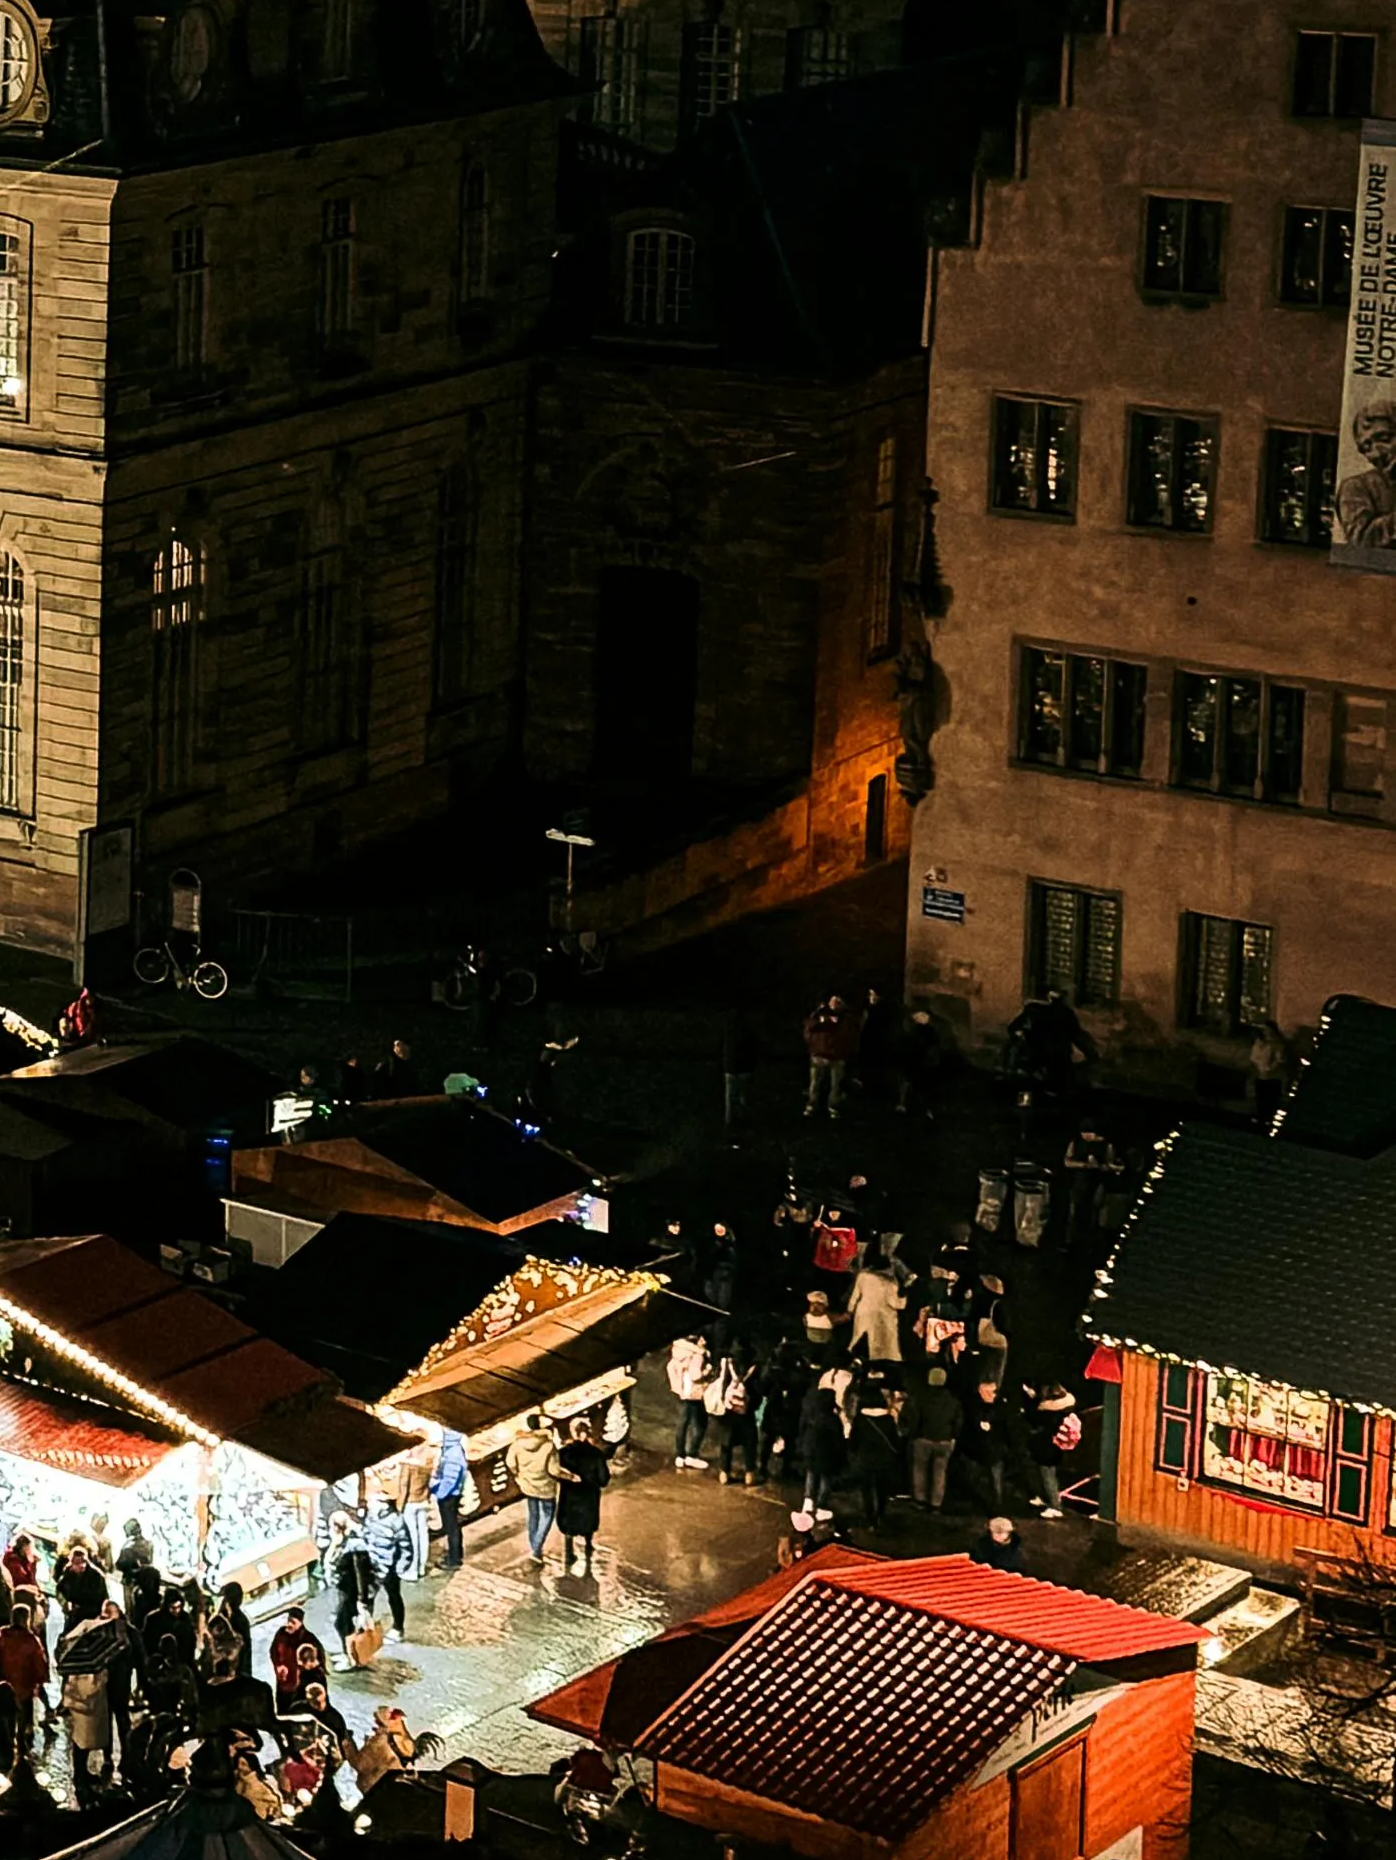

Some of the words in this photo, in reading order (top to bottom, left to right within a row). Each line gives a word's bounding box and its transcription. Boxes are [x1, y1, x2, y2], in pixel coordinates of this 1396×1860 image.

[1362, 163, 1388, 259] L'ŒUVRE
[1359, 264, 1380, 293] DE
[1353, 299, 1377, 376] MUSÉE
